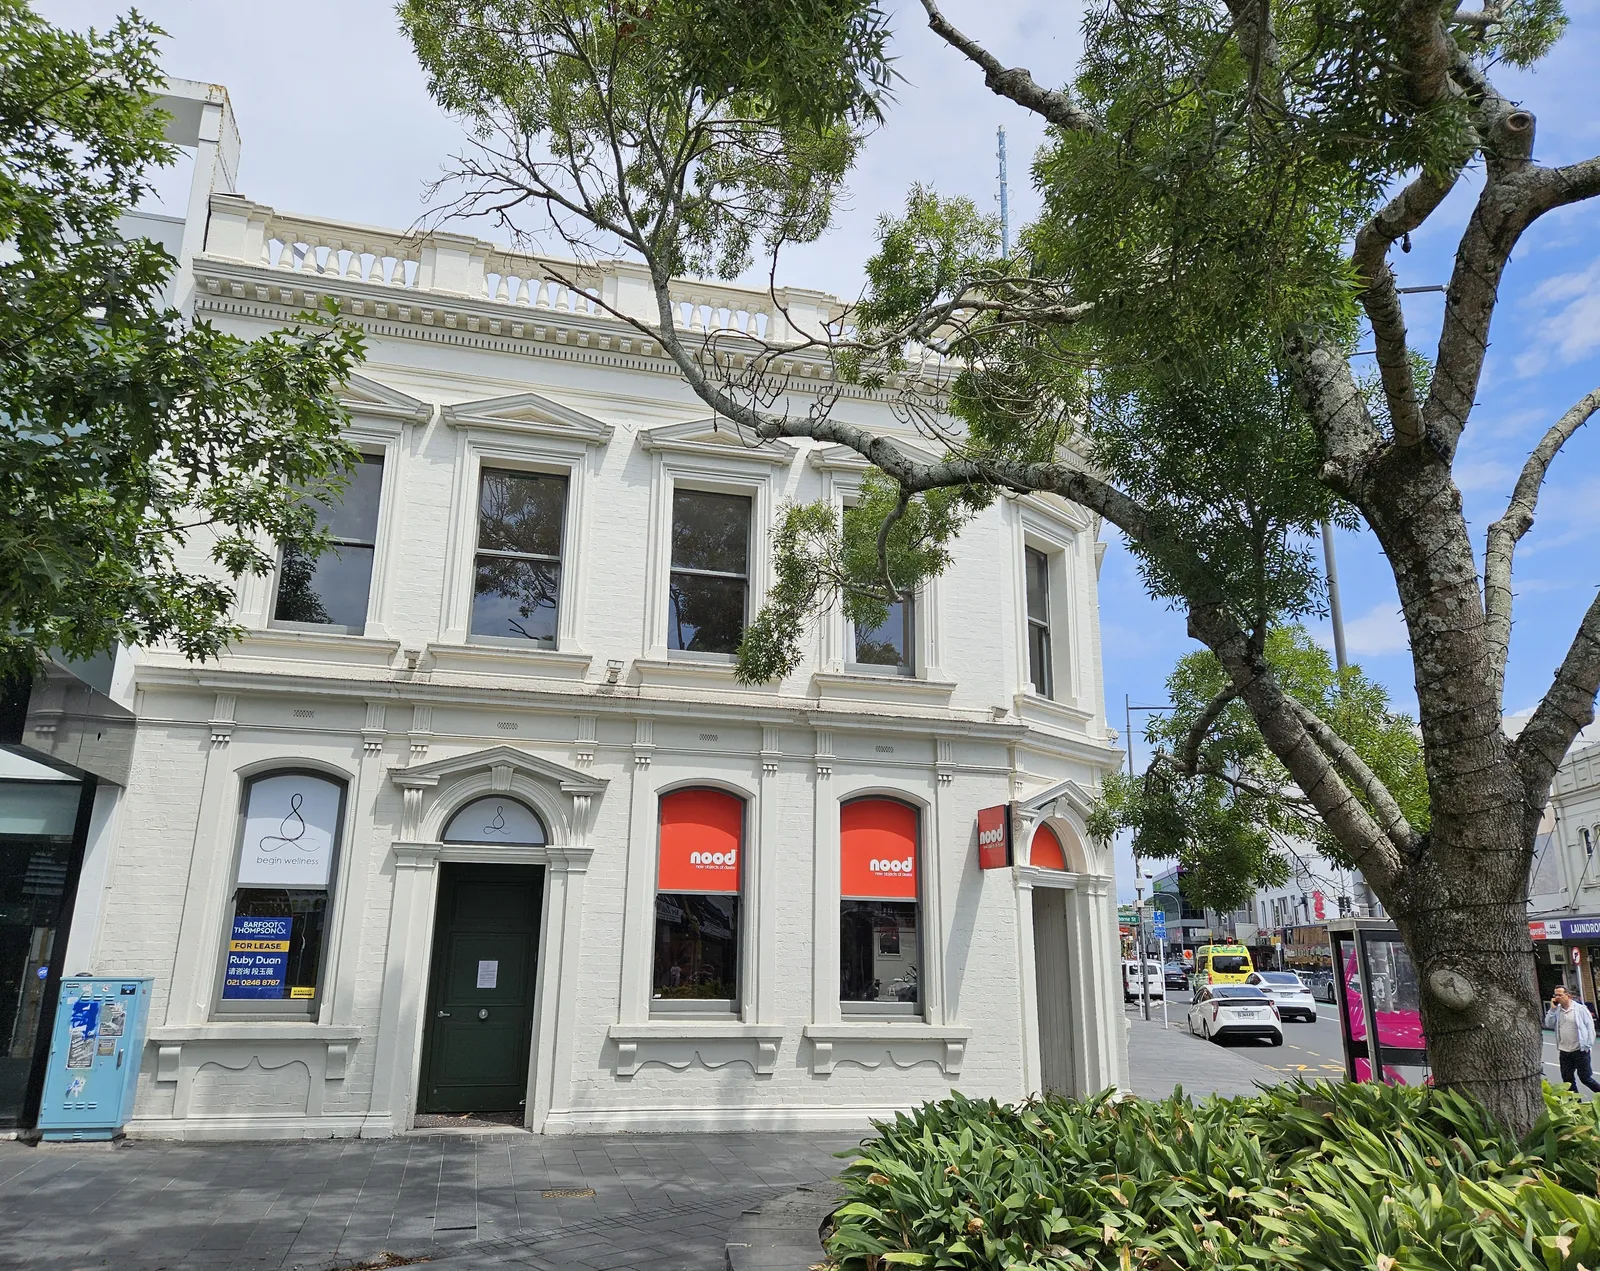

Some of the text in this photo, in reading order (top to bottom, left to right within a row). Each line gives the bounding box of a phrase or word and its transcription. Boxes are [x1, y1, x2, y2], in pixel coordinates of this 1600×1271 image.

[980, 824, 1003, 845] nood
[256, 856, 319, 866] begin wellness
[690, 849, 736, 865] nood
[869, 856, 913, 873] nood
[277, 921, 286, 935] &
[254, 942, 282, 950] LEASE
[230, 956, 281, 965] Ruby Duan
